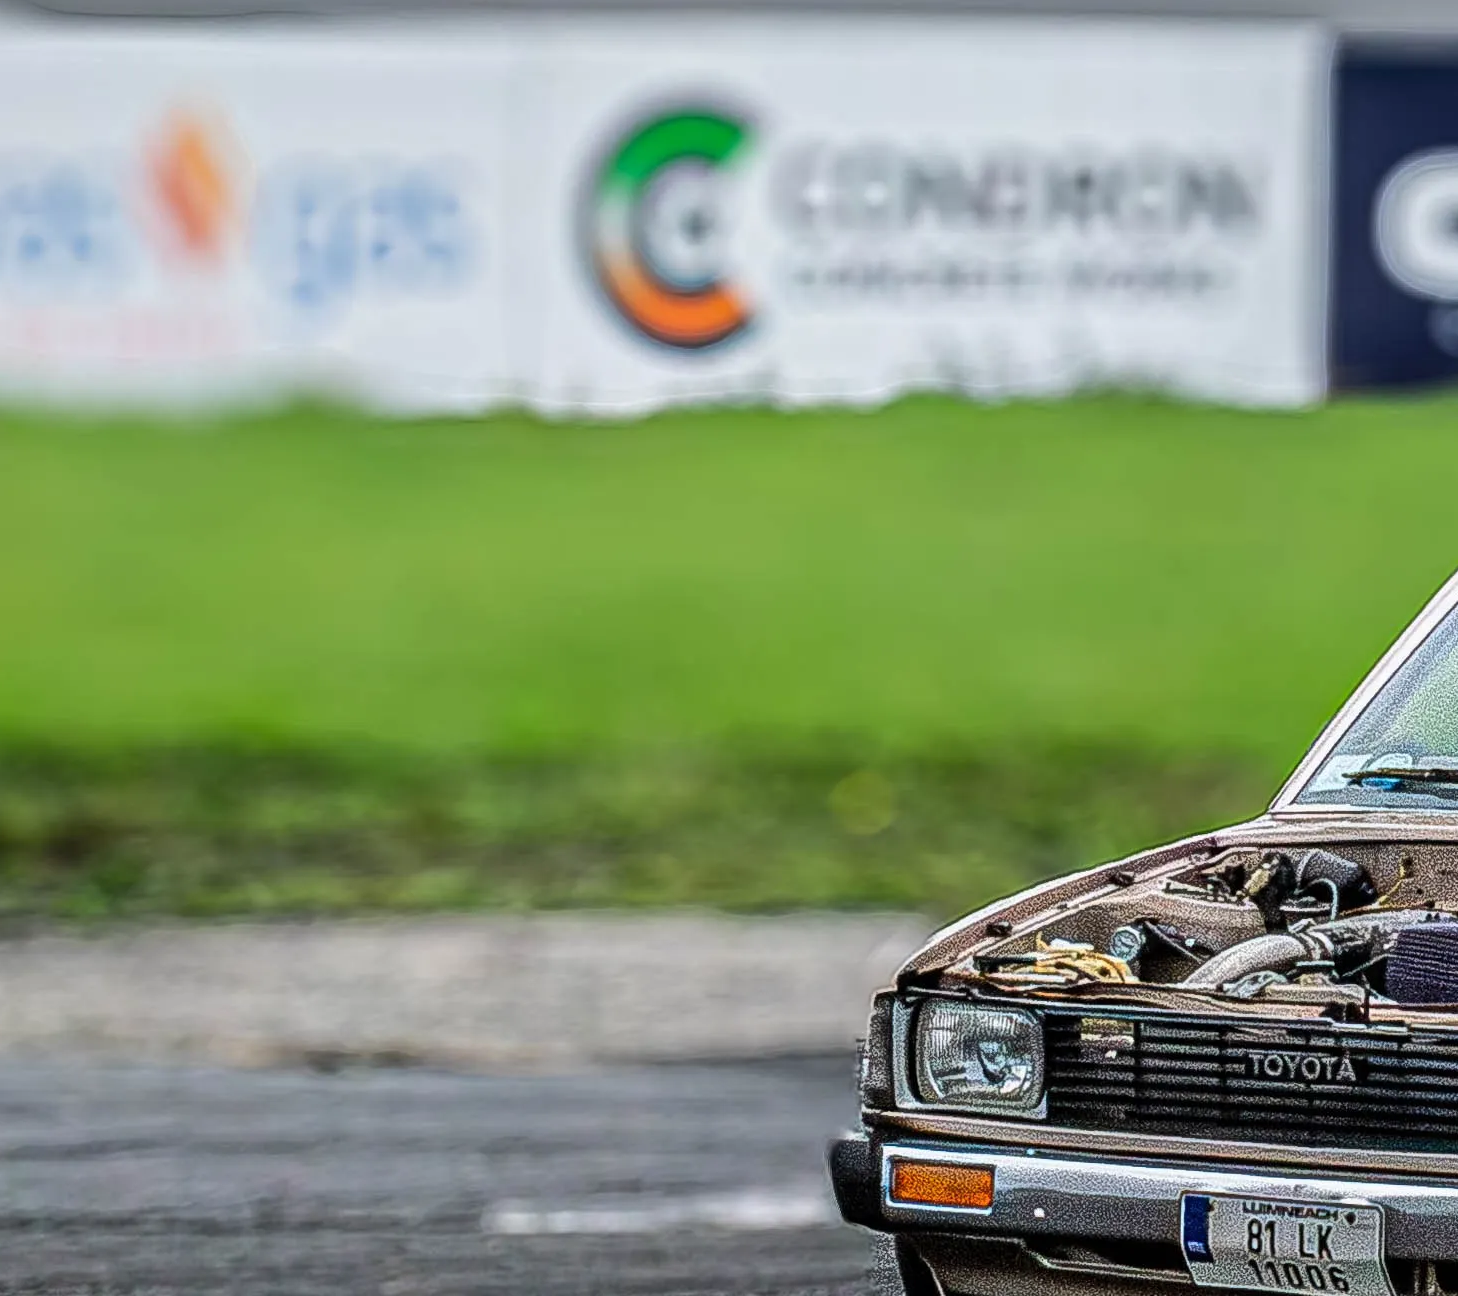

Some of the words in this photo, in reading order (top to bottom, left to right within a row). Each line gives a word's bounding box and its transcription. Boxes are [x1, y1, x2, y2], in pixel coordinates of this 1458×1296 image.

[1248, 1054, 1357, 1081] TOYOTA
[1247, 1218, 1276, 1255] 81
[1299, 1222, 1333, 1260] LK
[1248, 1259, 1350, 1294] 11006
